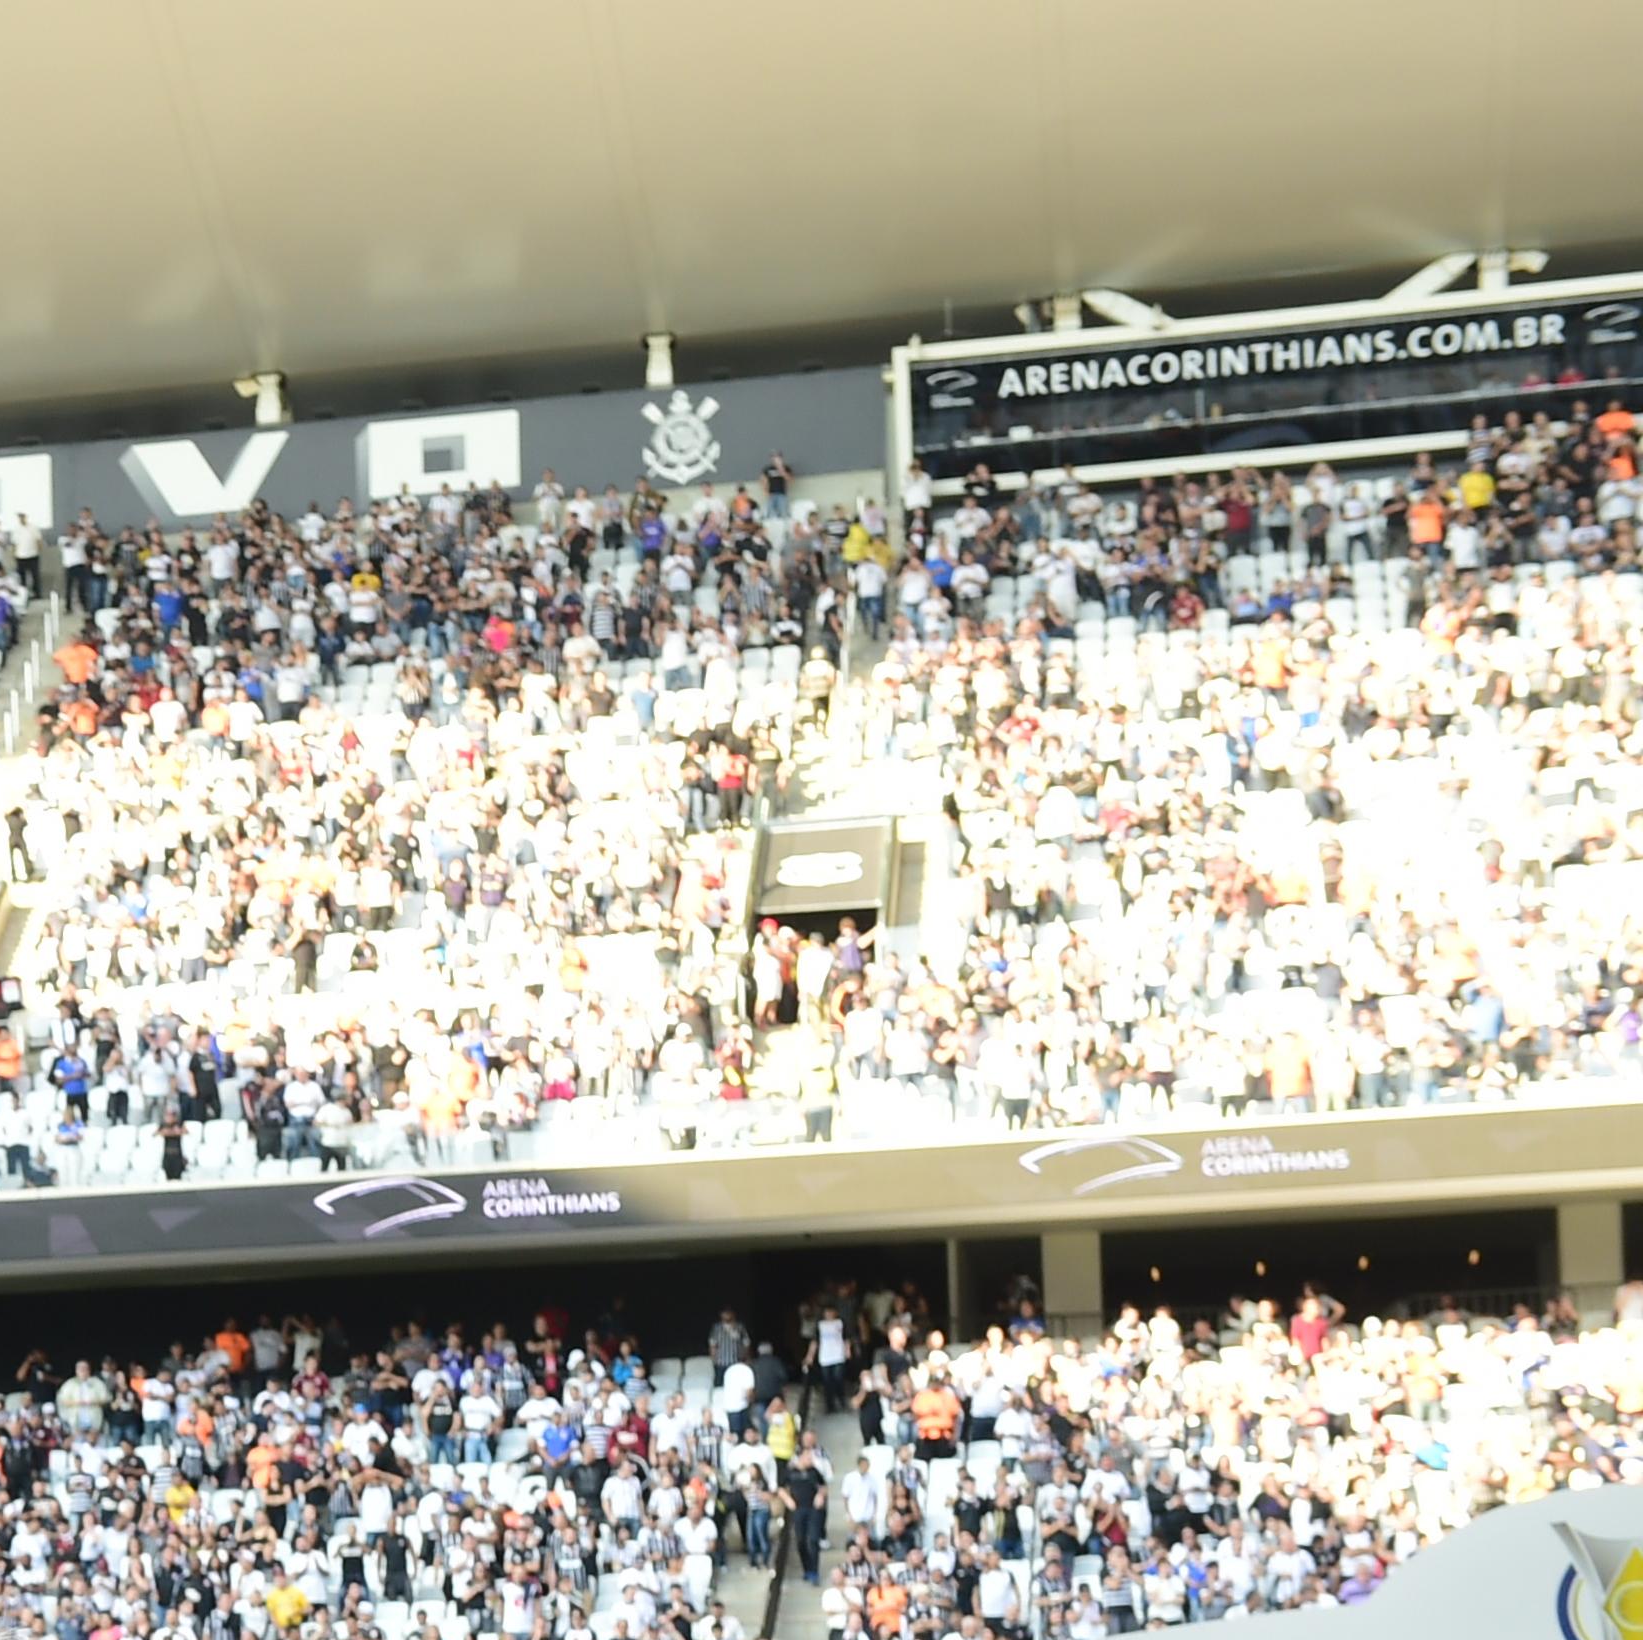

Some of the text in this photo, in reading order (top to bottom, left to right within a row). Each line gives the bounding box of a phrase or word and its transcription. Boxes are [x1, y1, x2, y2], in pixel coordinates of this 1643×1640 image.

[998, 314, 1565, 400] ARENACORINTHIANS.COM.BR
[1202, 1136, 1273, 1155] ARENA
[1201, 1148, 1350, 1178] CORINTHIANS
[482, 1177, 550, 1197] ARENA
[482, 1191, 621, 1218] CORINTHIANS
